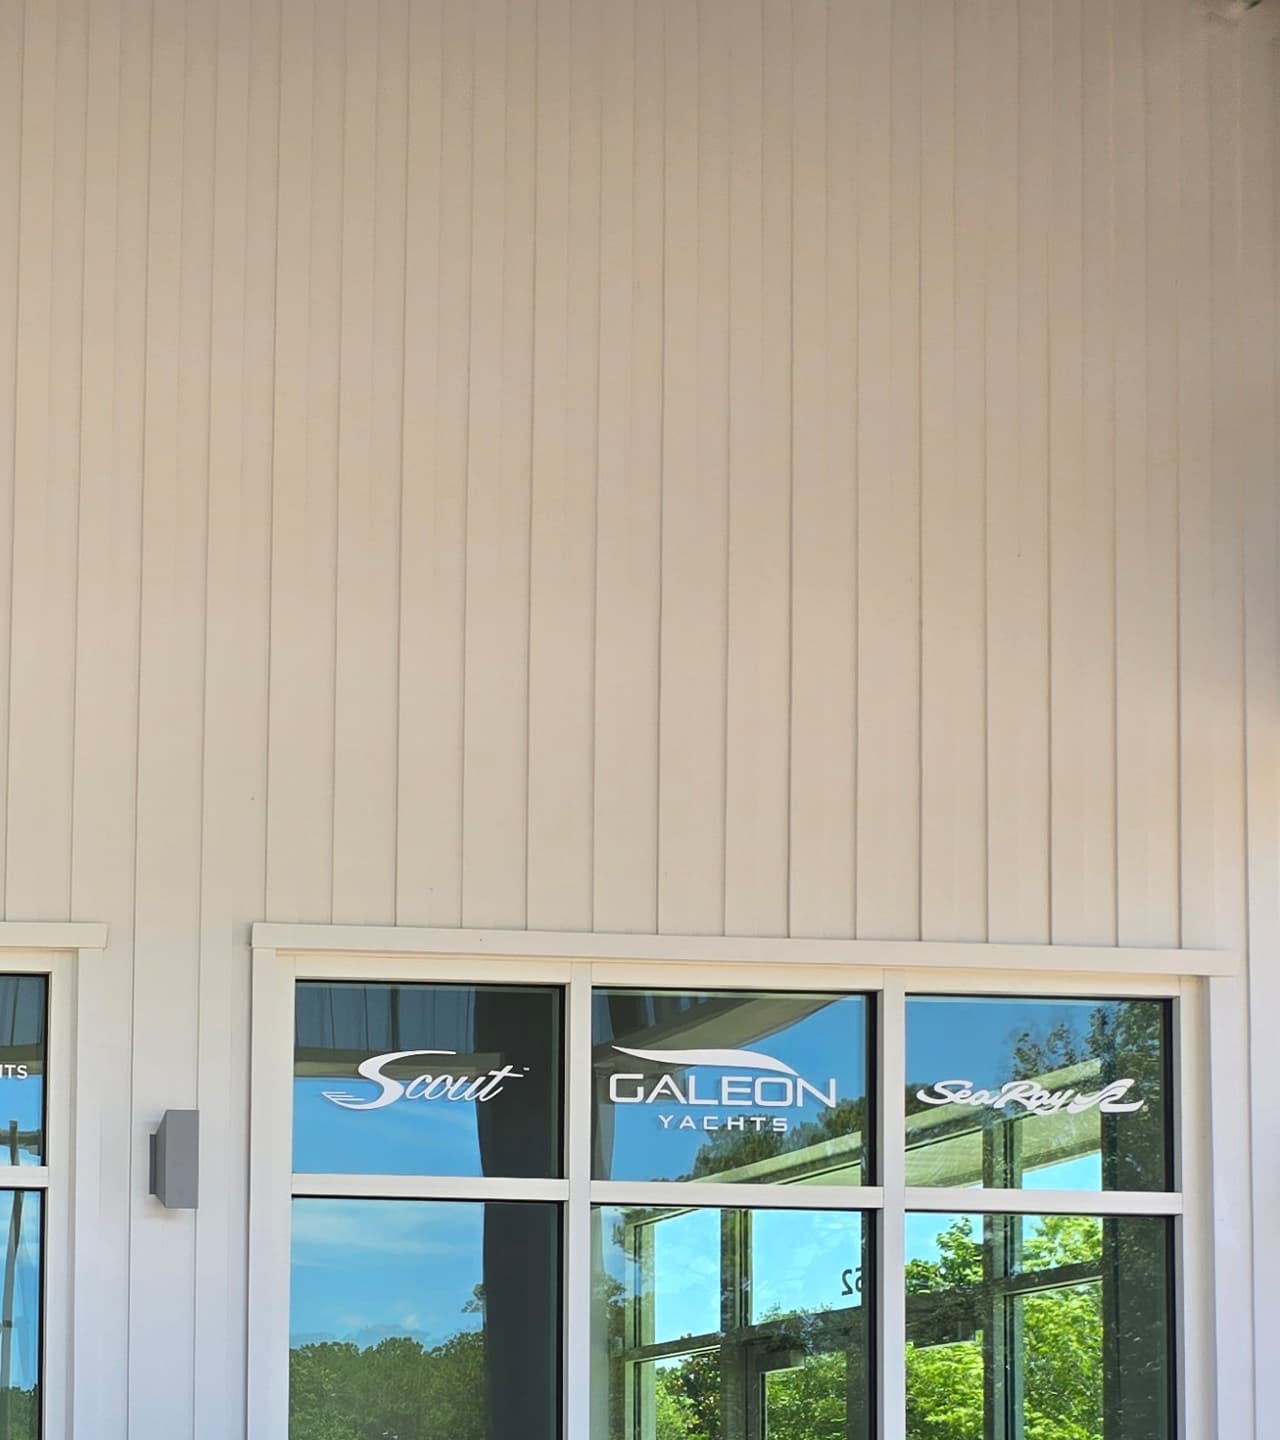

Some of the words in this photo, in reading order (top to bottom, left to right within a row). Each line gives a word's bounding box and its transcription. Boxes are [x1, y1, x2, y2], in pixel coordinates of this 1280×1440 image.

[321, 1050, 525, 1111] Scout
[609, 1073, 838, 1109] GALEON
[916, 1080, 1001, 1106] Sea
[993, 1080, 1075, 1115] Ray
[658, 1114, 789, 1133] YACHTS
